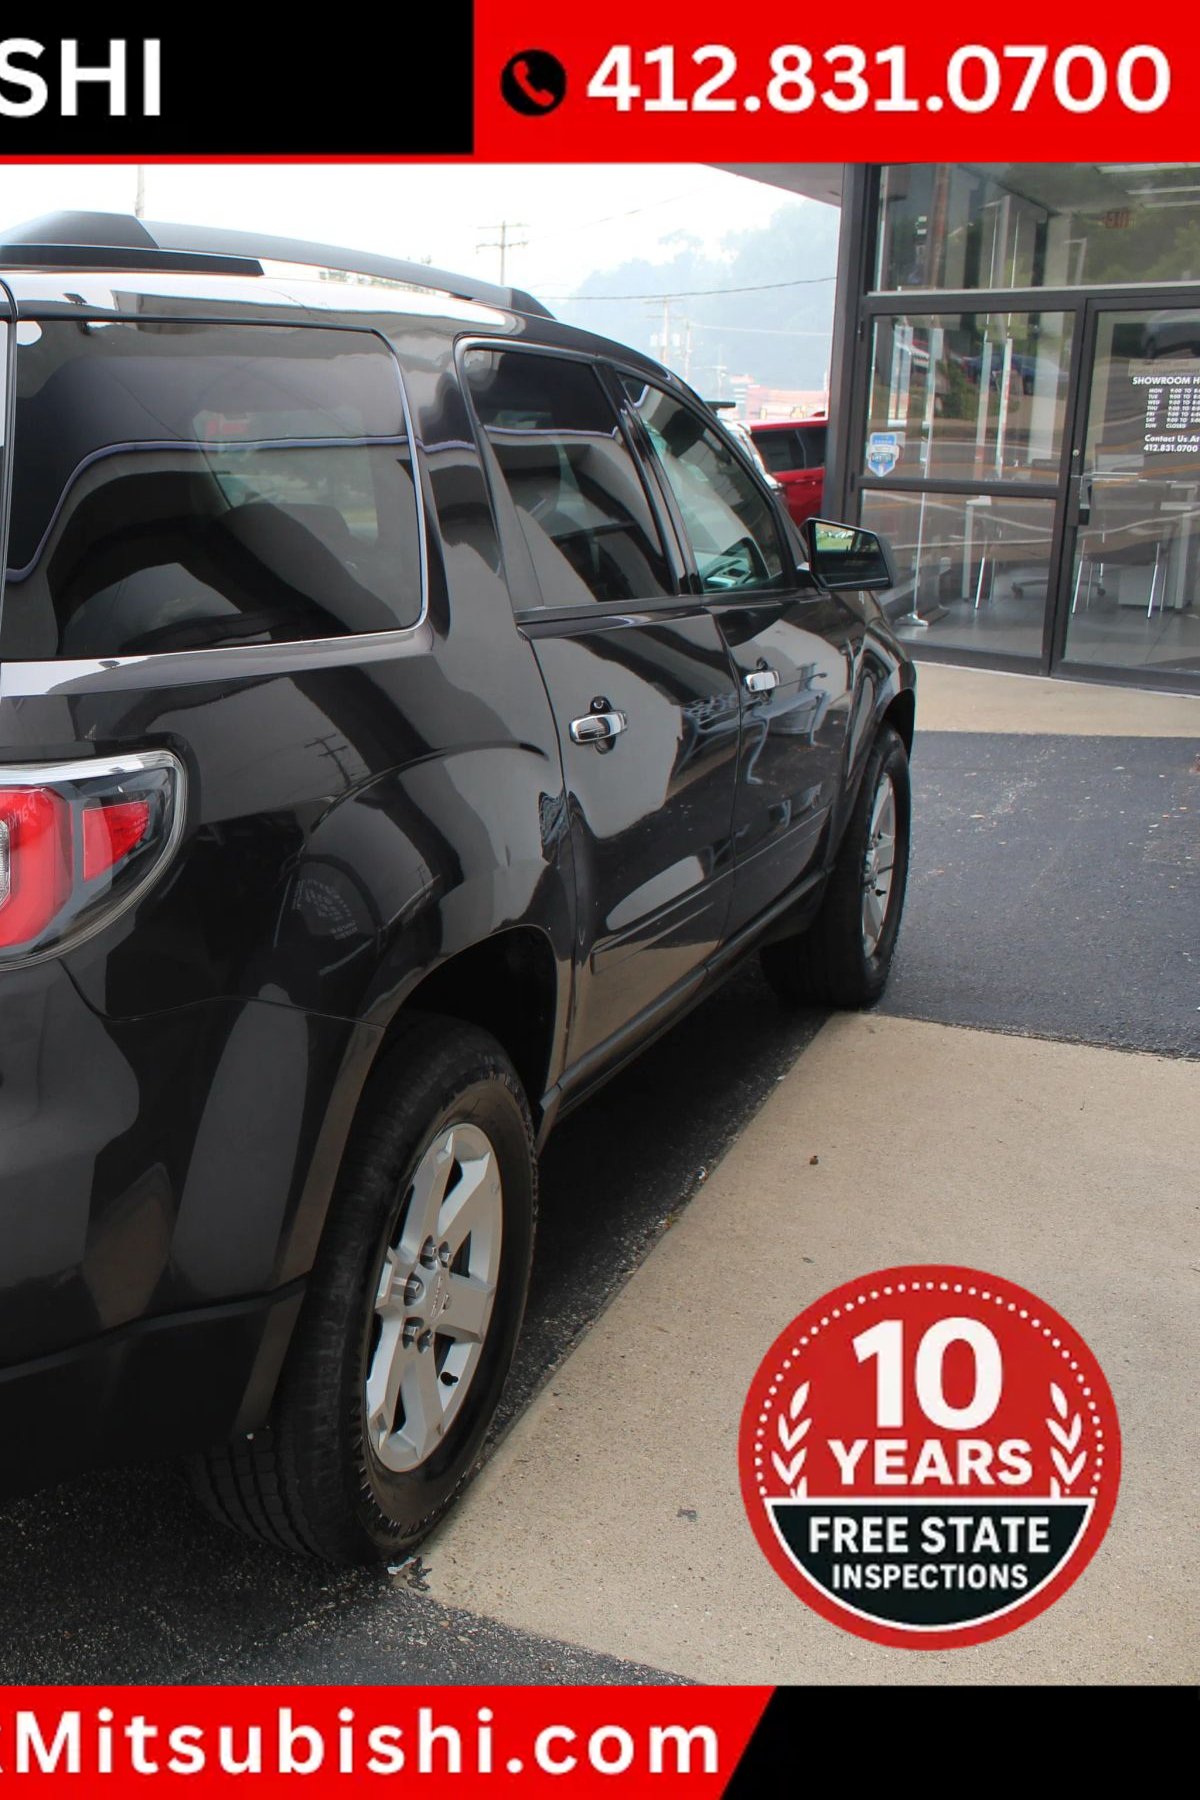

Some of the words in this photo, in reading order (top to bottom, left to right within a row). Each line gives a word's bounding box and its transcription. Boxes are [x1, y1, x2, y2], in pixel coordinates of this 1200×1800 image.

[1132, 376, 1190, 385] SHOWROOM
[1144, 434, 1175, 443] Contact
[1177, 435, 1188, 443] Us
[1190, 435, 1200, 443] At
[1143, 444, 1198, 453] 412.831.0700
